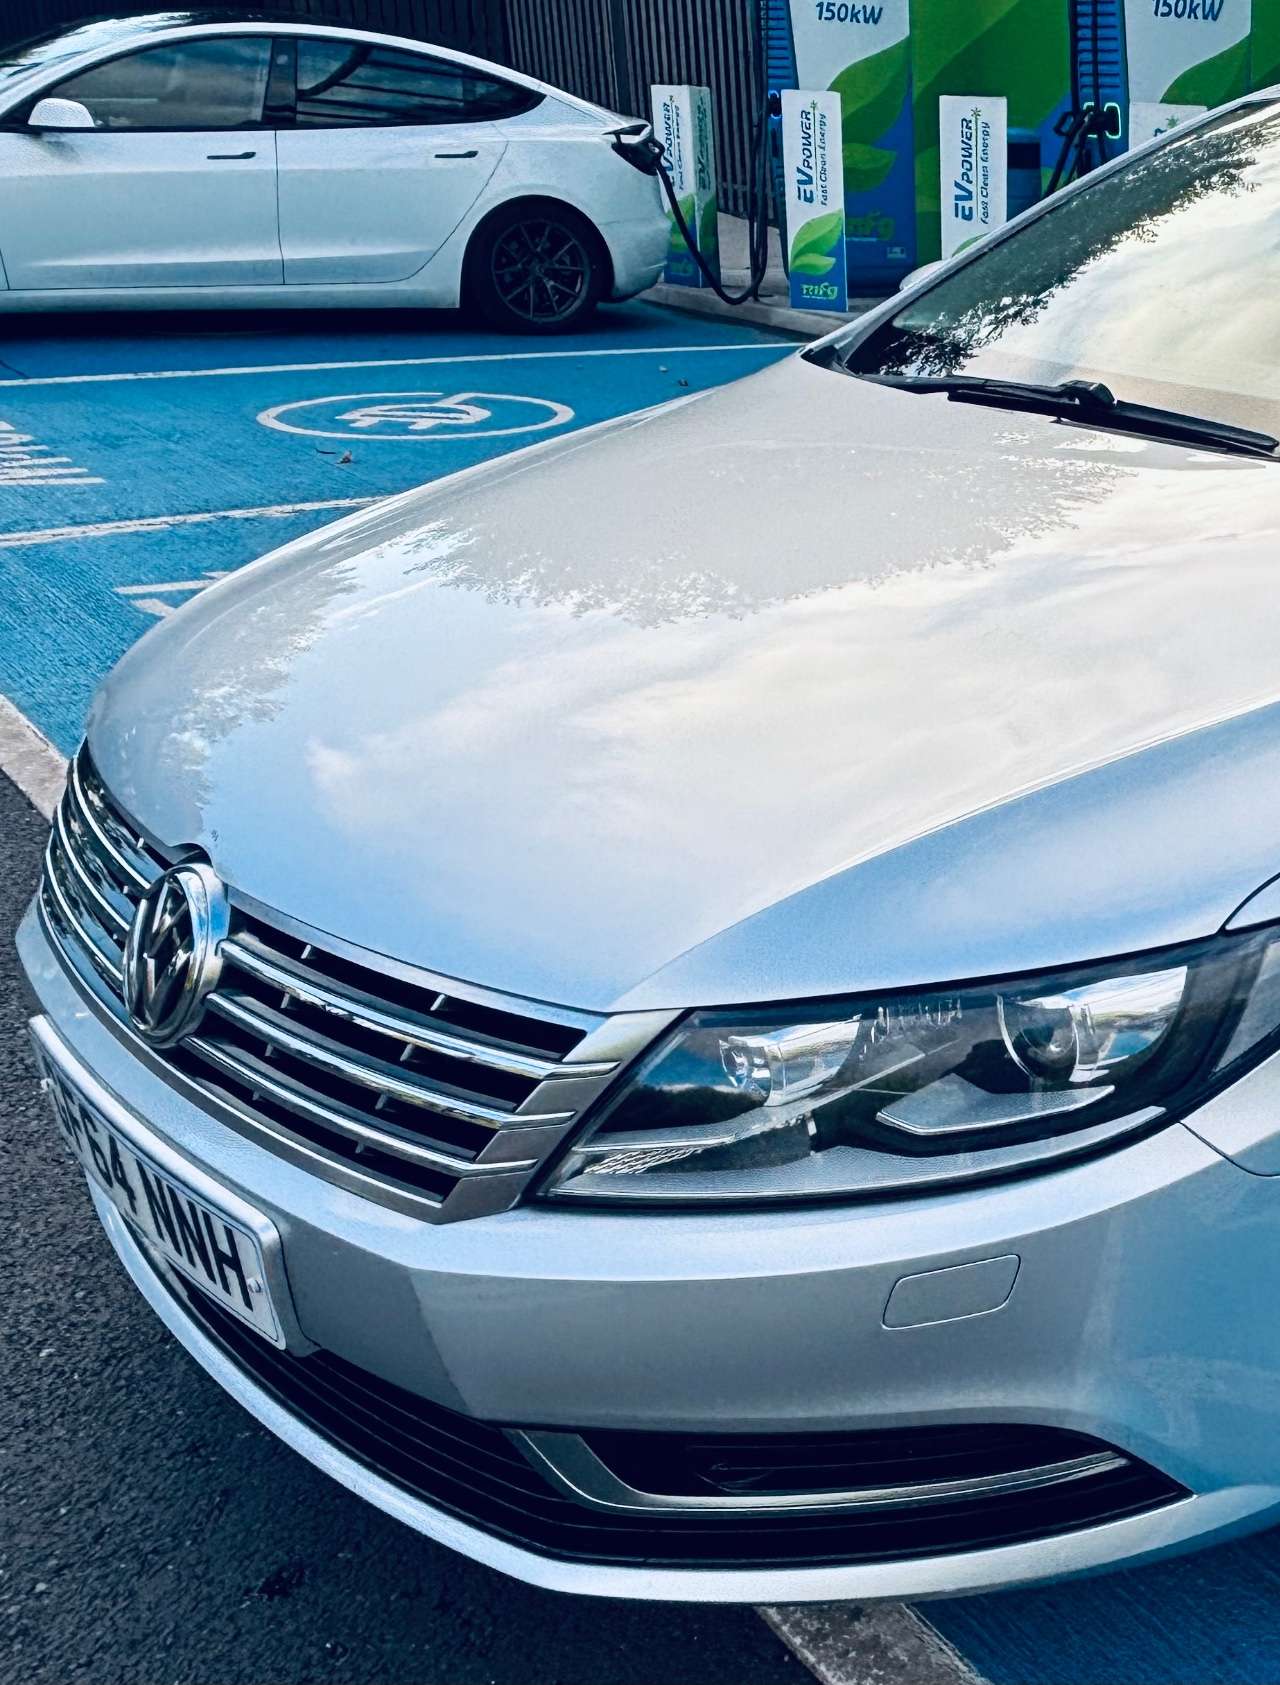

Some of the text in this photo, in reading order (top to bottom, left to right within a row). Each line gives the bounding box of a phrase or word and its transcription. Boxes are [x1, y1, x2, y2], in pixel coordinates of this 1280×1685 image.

[815, 2, 883, 25] 150kW
[1153, 0, 1224, 21] 150kW
[135, 1158, 255, 1313] NNH
